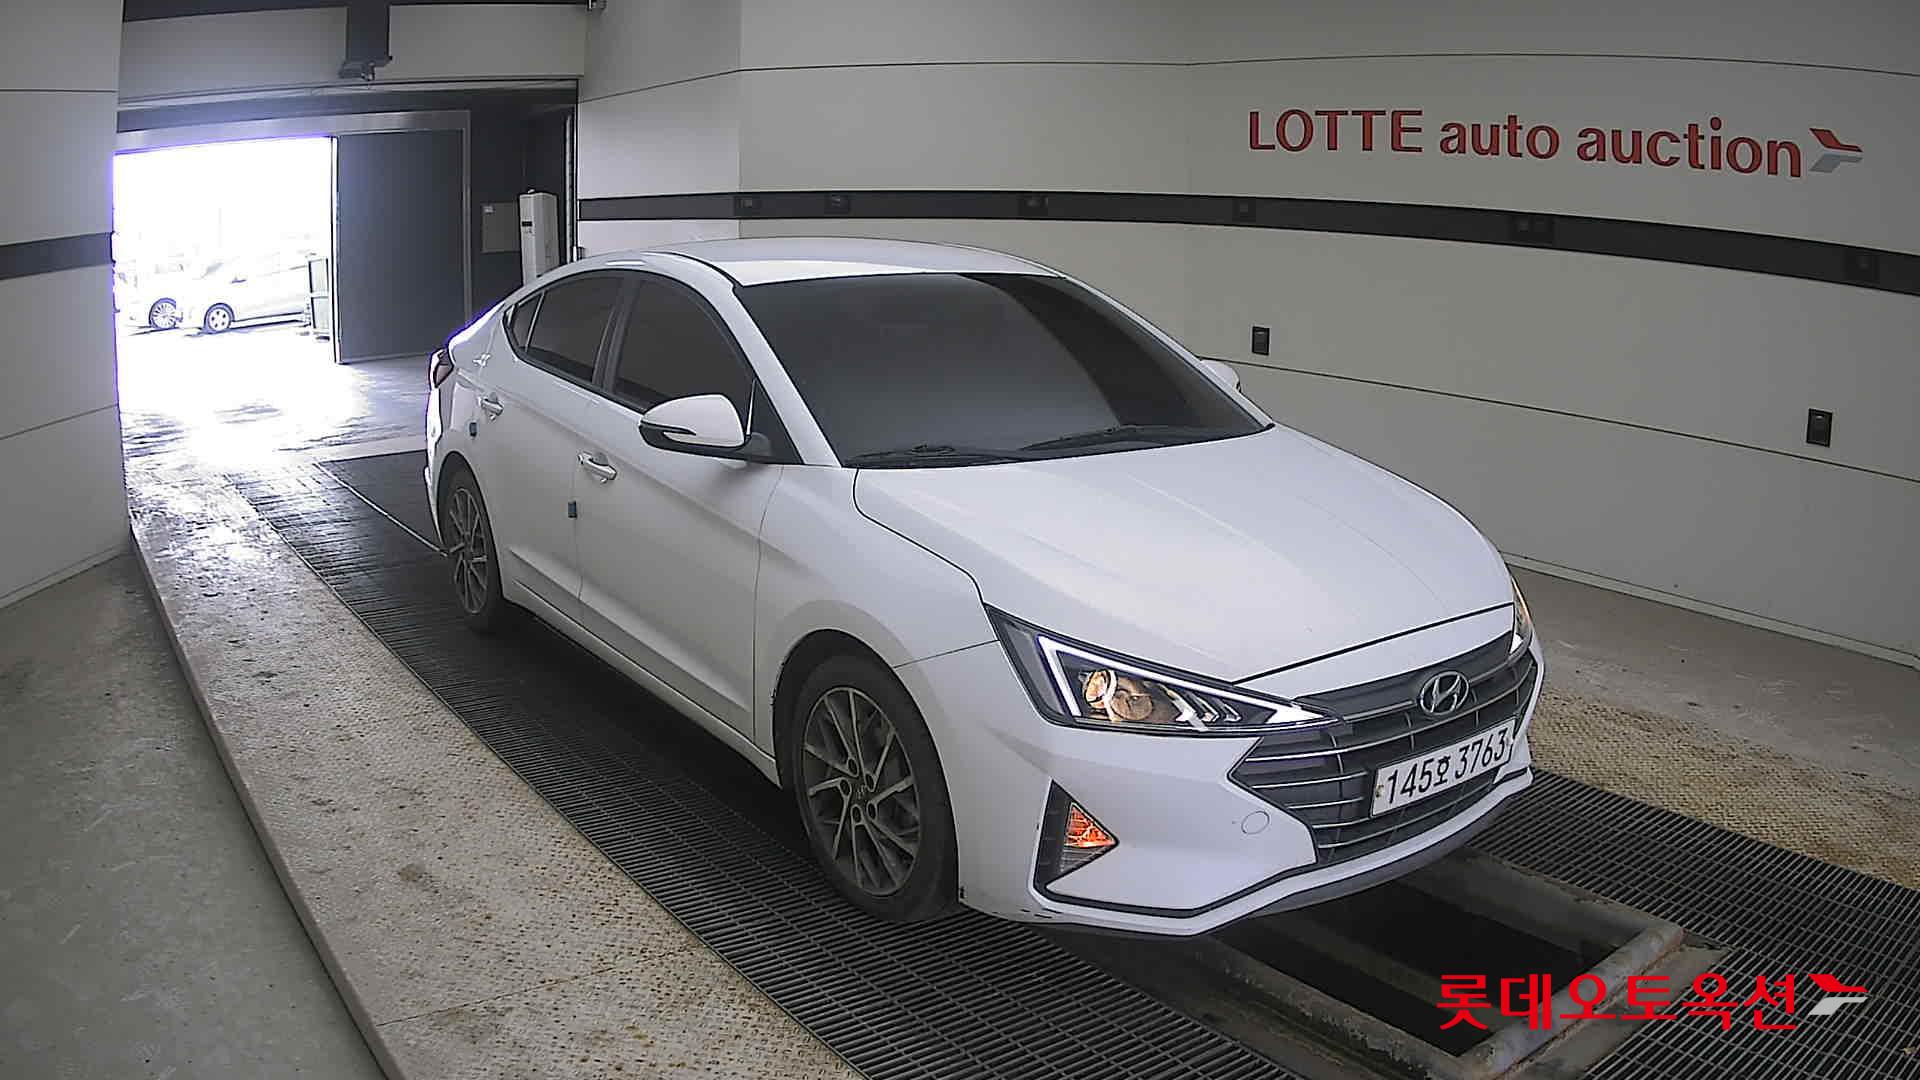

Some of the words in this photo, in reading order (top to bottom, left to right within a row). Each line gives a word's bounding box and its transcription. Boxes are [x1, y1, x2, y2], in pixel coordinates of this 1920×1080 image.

[1248, 109, 1424, 153] LOTTE
[1439, 113, 1560, 159] auto
[1575, 116, 1801, 177] auction
[1454, 727, 1508, 779] 3763
